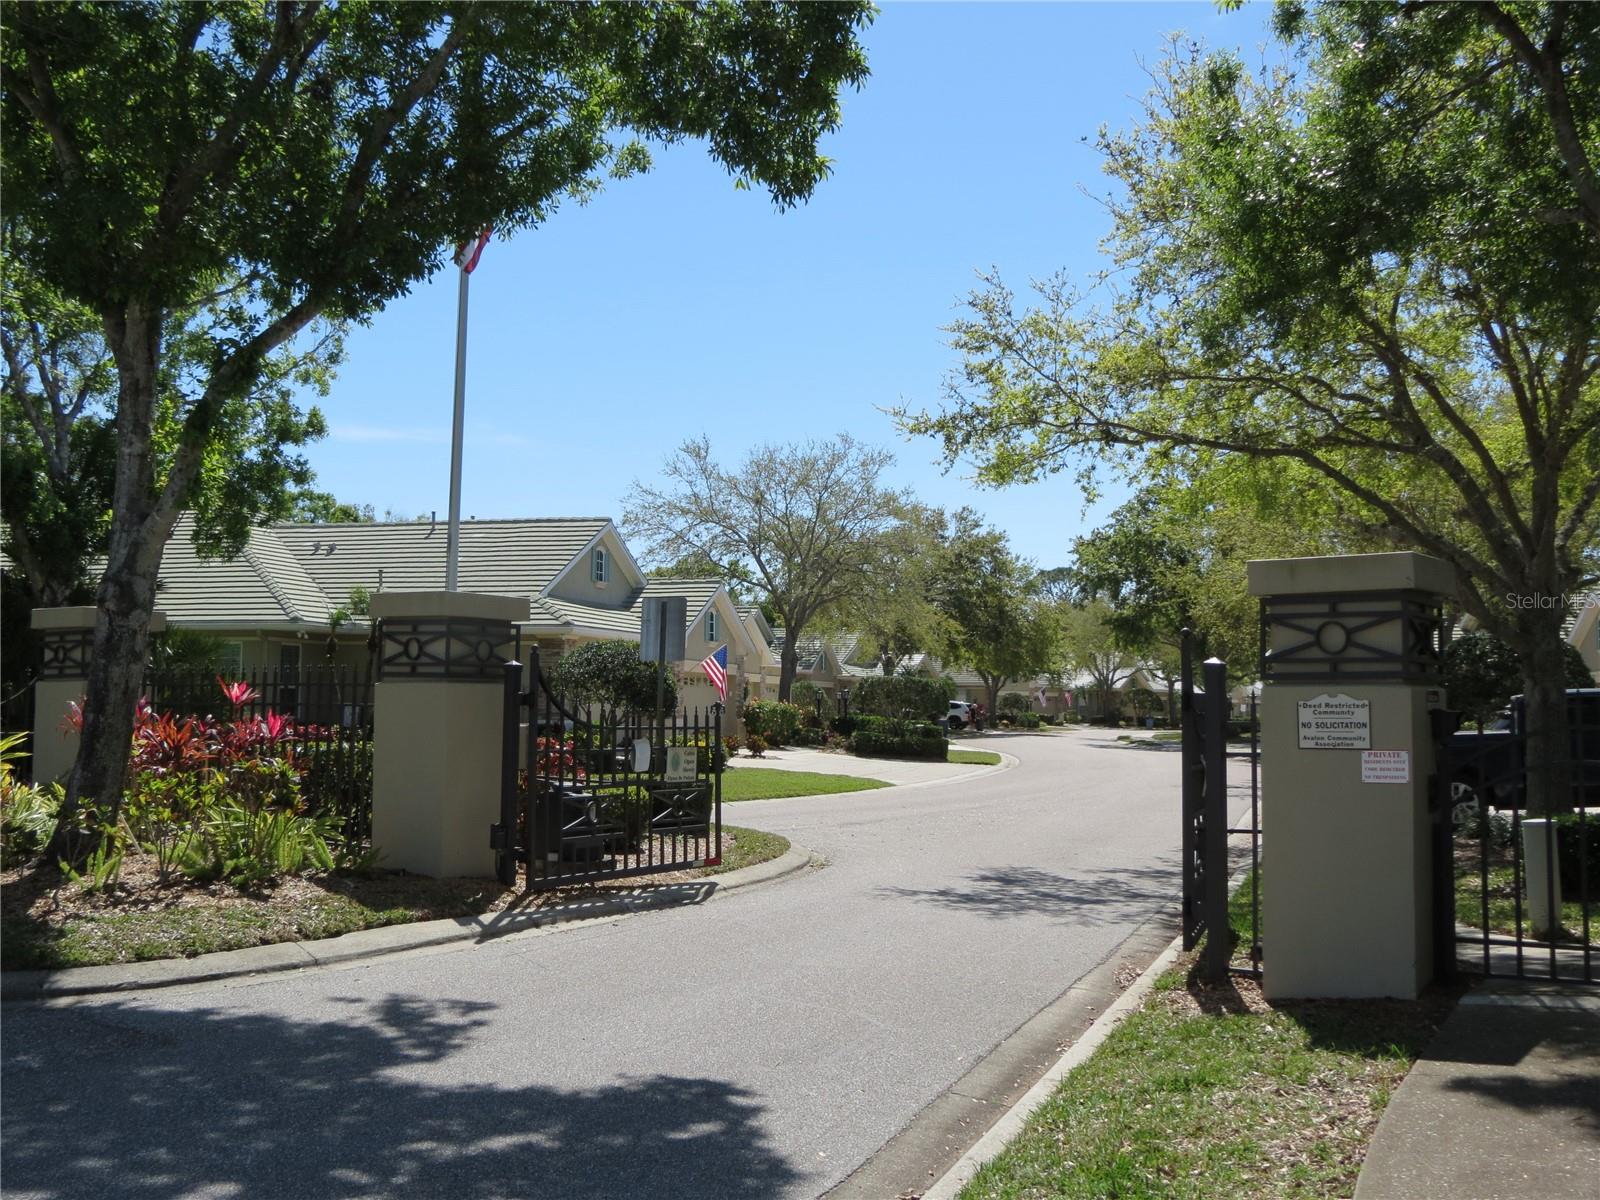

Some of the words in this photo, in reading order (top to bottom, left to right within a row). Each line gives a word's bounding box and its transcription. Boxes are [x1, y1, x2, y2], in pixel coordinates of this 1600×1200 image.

[1312, 709, 1355, 717] Community
[1315, 721, 1367, 729] SOLICITATION
[1326, 734, 1366, 742] Community
